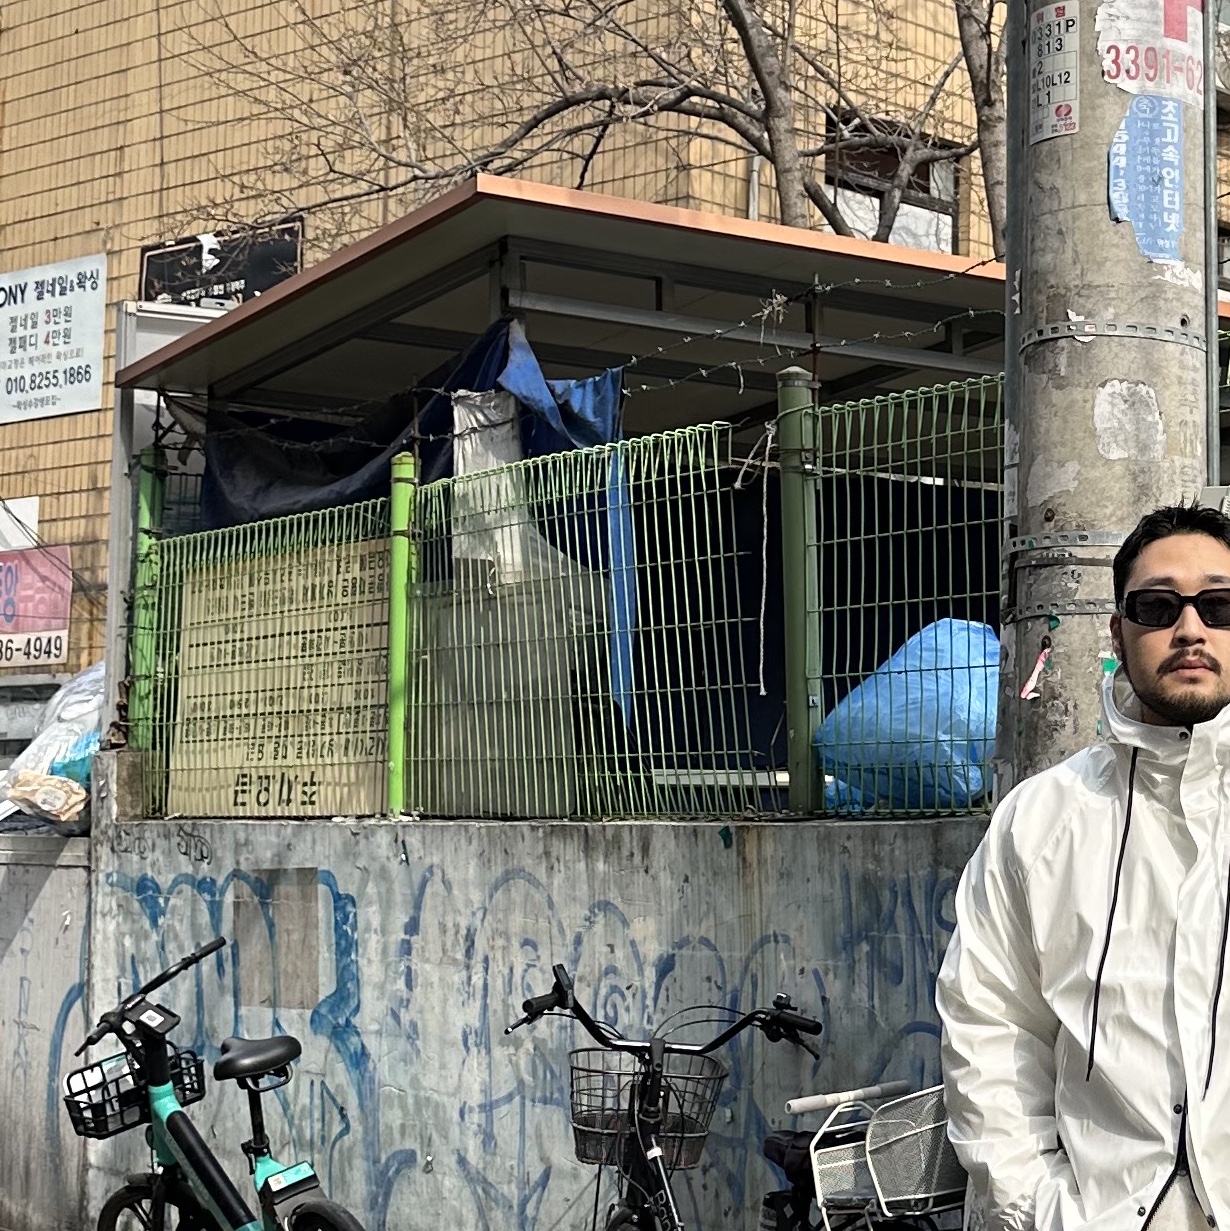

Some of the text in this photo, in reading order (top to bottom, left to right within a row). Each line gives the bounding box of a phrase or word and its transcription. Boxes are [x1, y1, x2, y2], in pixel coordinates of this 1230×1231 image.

[1037, 37, 1063, 58] 813
[1160, 99, 1182, 233] 초고속인터넷
[9, 304, 73, 334] 젤네일 3만원
[44, 326, 72, 347] 4만원
[6, 364, 92, 395] 010.8255.1866
